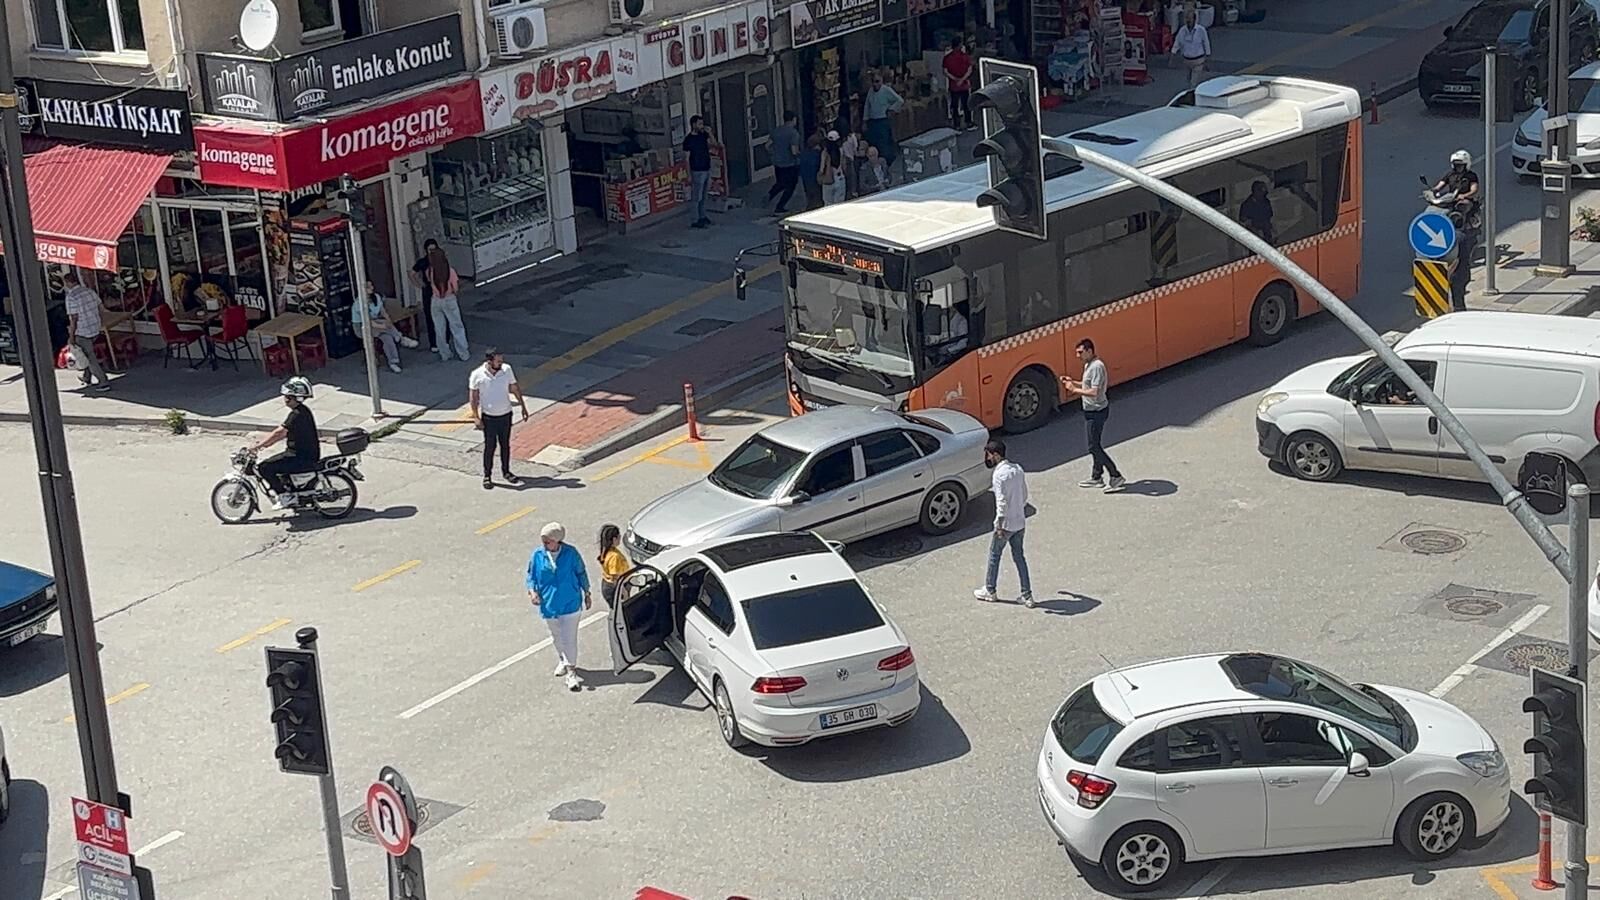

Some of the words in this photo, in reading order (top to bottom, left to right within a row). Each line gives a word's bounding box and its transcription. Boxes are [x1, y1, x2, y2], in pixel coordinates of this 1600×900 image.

[667, 16, 768, 68] GÜNEŞ
[331, 53, 384, 90] Emlak
[385, 58, 395, 76] &
[395, 36, 452, 72] Konut
[514, 50, 612, 100] BÜŞRA
[40, 97, 117, 128] KAYALAR
[117, 98, 182, 138] İNŞAAT
[222, 98, 257, 110] KAYALAR
[320, 104, 450, 162] komagene
[201, 142, 274, 171] komagene
[828, 714, 838, 724] 35
[858, 706, 875, 718] 030
[84, 823, 113, 842] ACİL
